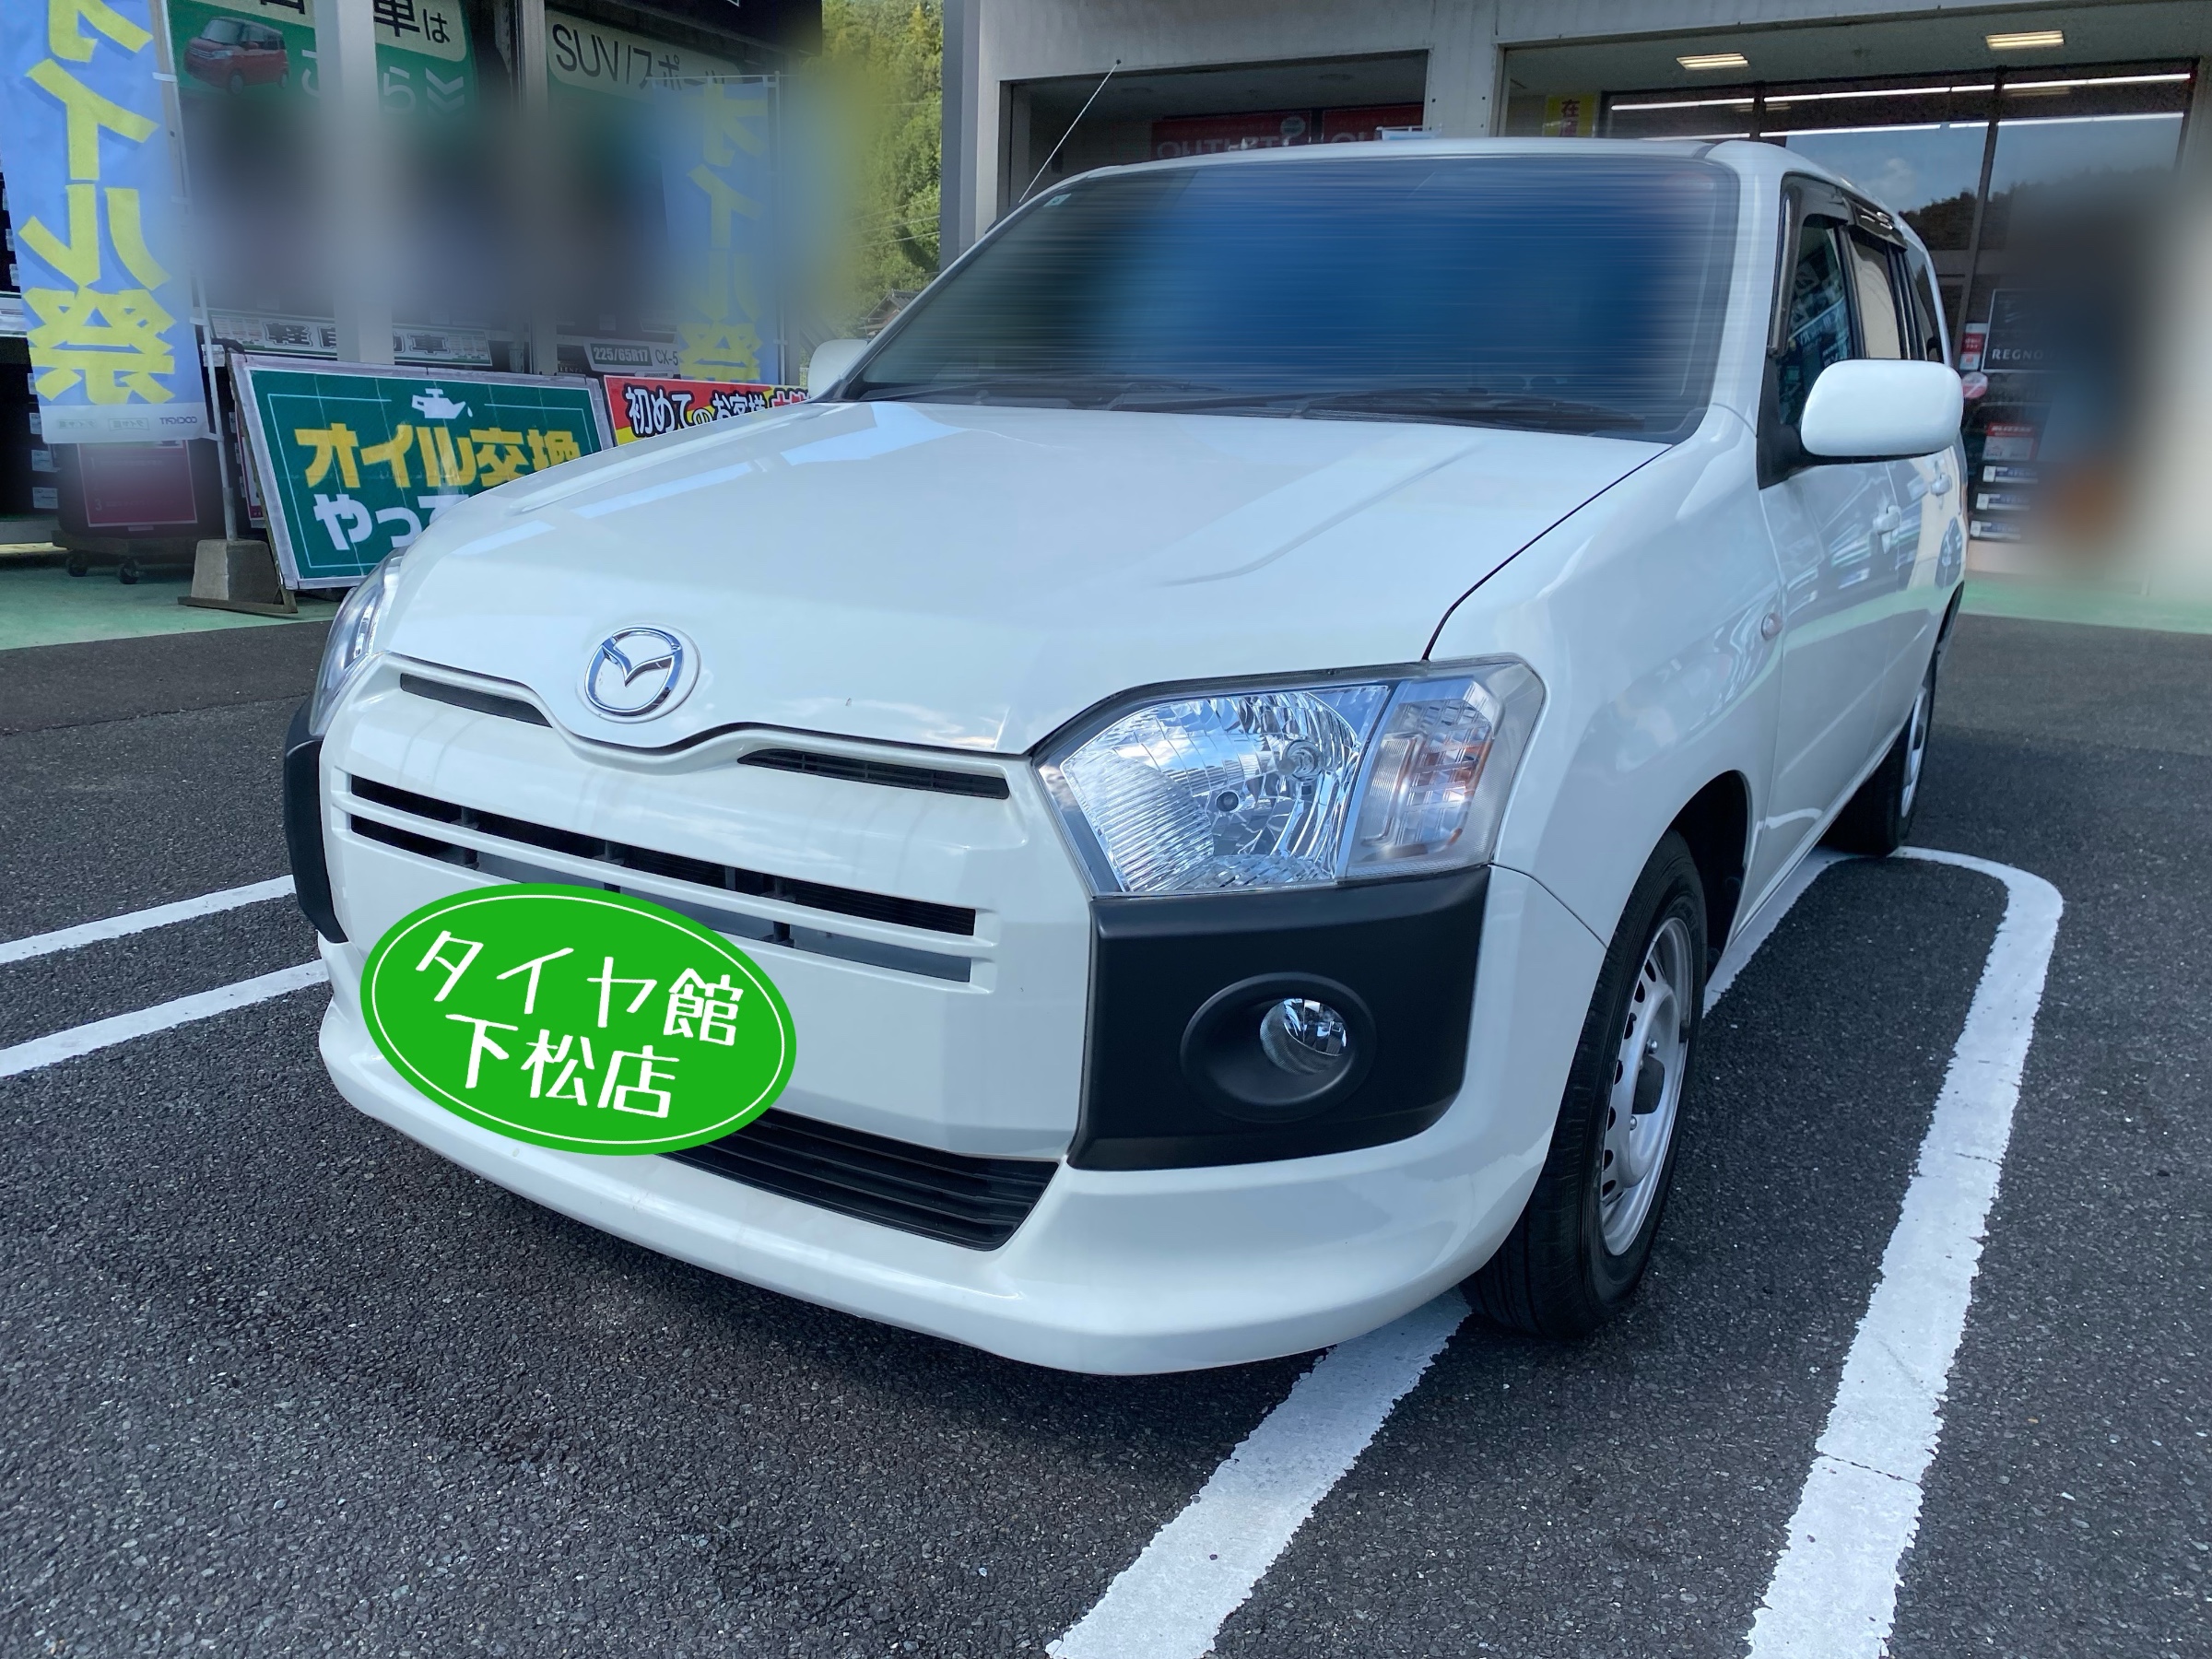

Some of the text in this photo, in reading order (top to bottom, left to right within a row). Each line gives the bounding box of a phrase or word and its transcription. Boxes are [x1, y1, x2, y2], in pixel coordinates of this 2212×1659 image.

[593, 347, 679, 366] 225/65R17 CX-5
[294, 422, 582, 488] オイル交換
